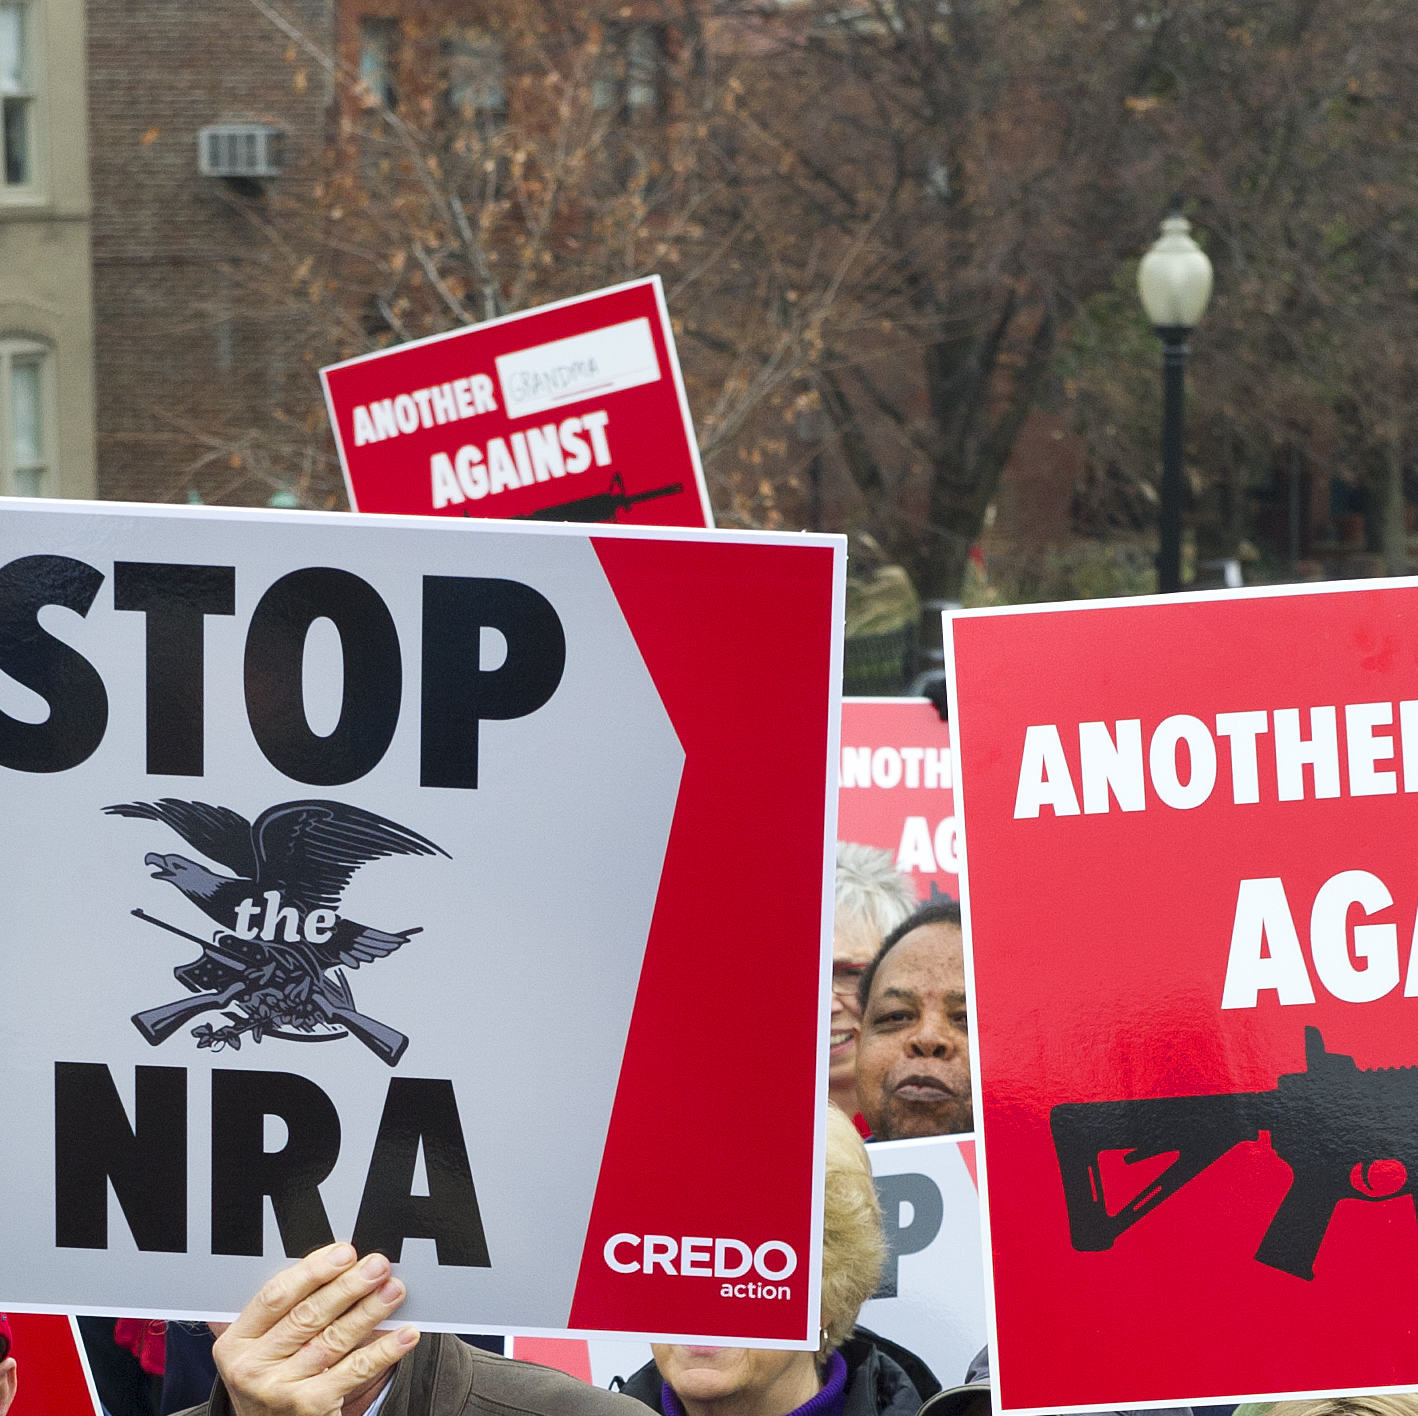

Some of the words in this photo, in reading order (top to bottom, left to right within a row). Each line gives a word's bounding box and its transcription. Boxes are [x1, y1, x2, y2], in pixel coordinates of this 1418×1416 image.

[352, 373, 498, 447] ANOTHER
[431, 410, 612, 509] AGAINST
[234, 890, 336, 944] the
[55, 1062, 491, 1268] NRA
[604, 1233, 798, 1281] CREDO
[720, 1281, 791, 1301] action
